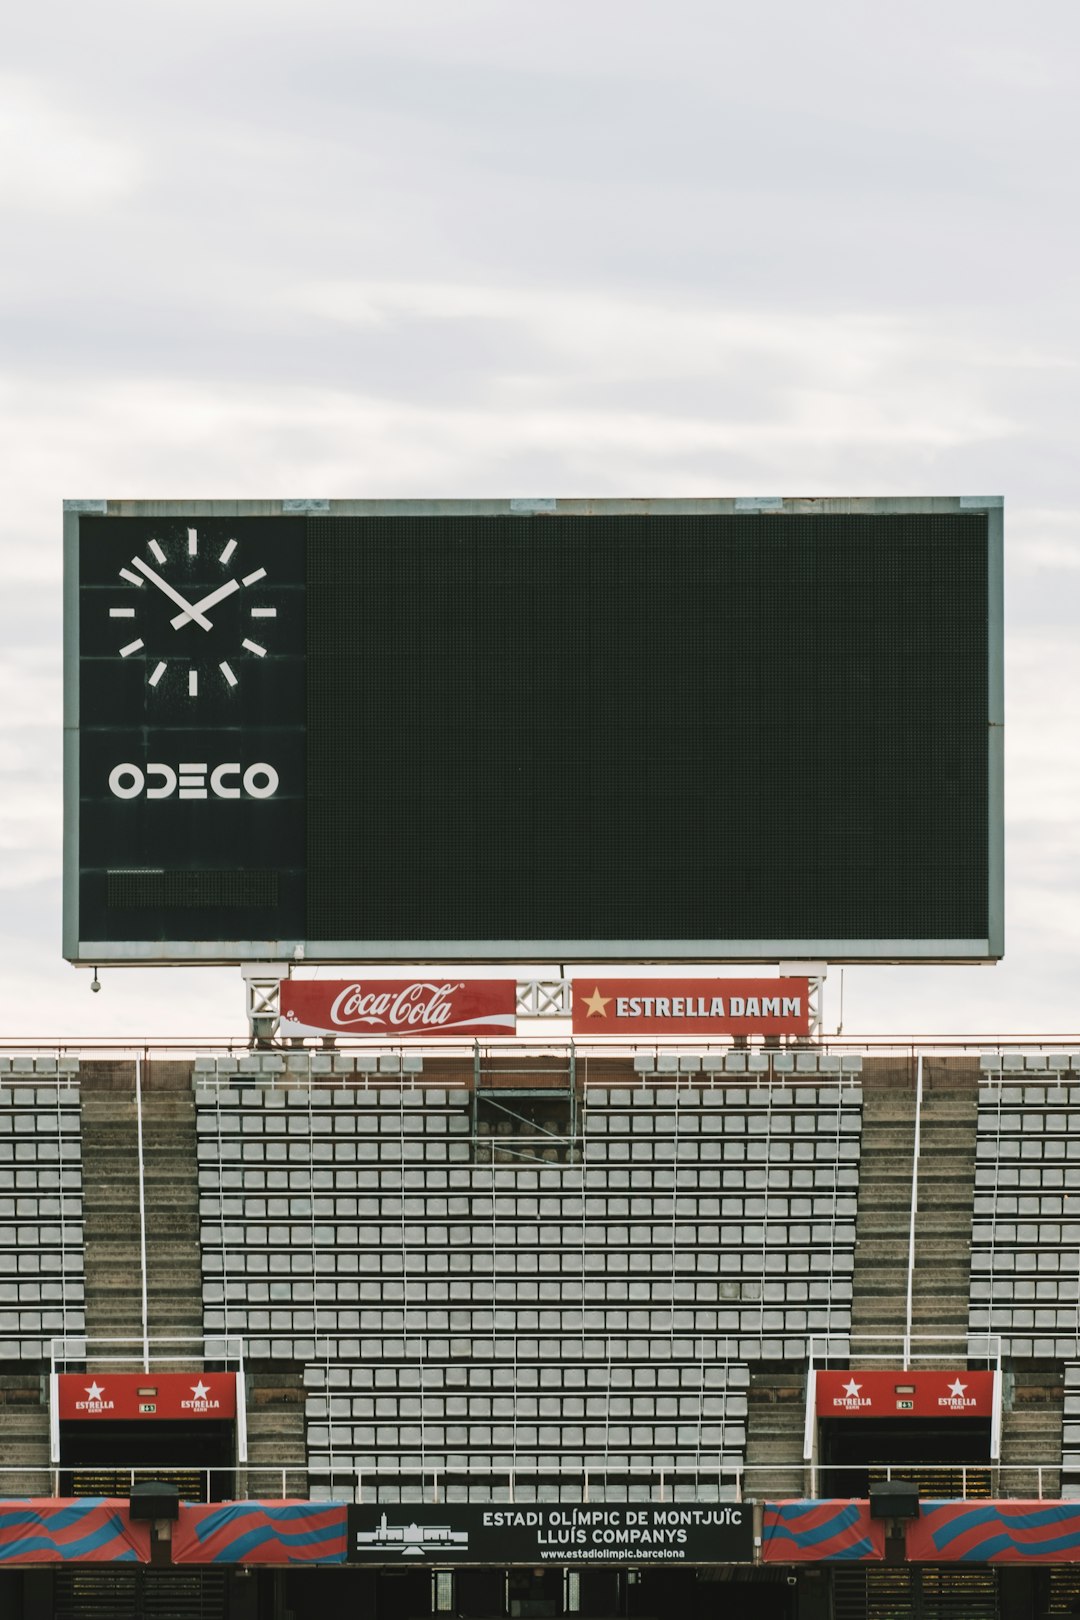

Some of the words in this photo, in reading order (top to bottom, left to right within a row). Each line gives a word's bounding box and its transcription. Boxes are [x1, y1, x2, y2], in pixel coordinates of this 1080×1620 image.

[108, 762, 280, 800] ODECO
[330, 983, 459, 1026] Coca-Cola
[615, 996, 724, 1019] ESTRELLA
[729, 996, 802, 1018] DAMM
[75, 1401, 114, 1410] ESTRELLA
[180, 1400, 220, 1408] ESTRELLA
[833, 1397, 872, 1406] ESTRELLA
[938, 1397, 977, 1406] ESTRELLA
[483, 1511, 543, 1526] ESTADI
[548, 1508, 620, 1525] OLÍMPIC
[625, 1511, 649, 1525] DE
[653, 1508, 742, 1525] MONTJUÏC
[537, 1526, 587, 1544] LLUÍS
[592, 1529, 688, 1543] COMPANYS
[540, 1549, 685, 1560] www.estadiolimpic.barcelona
